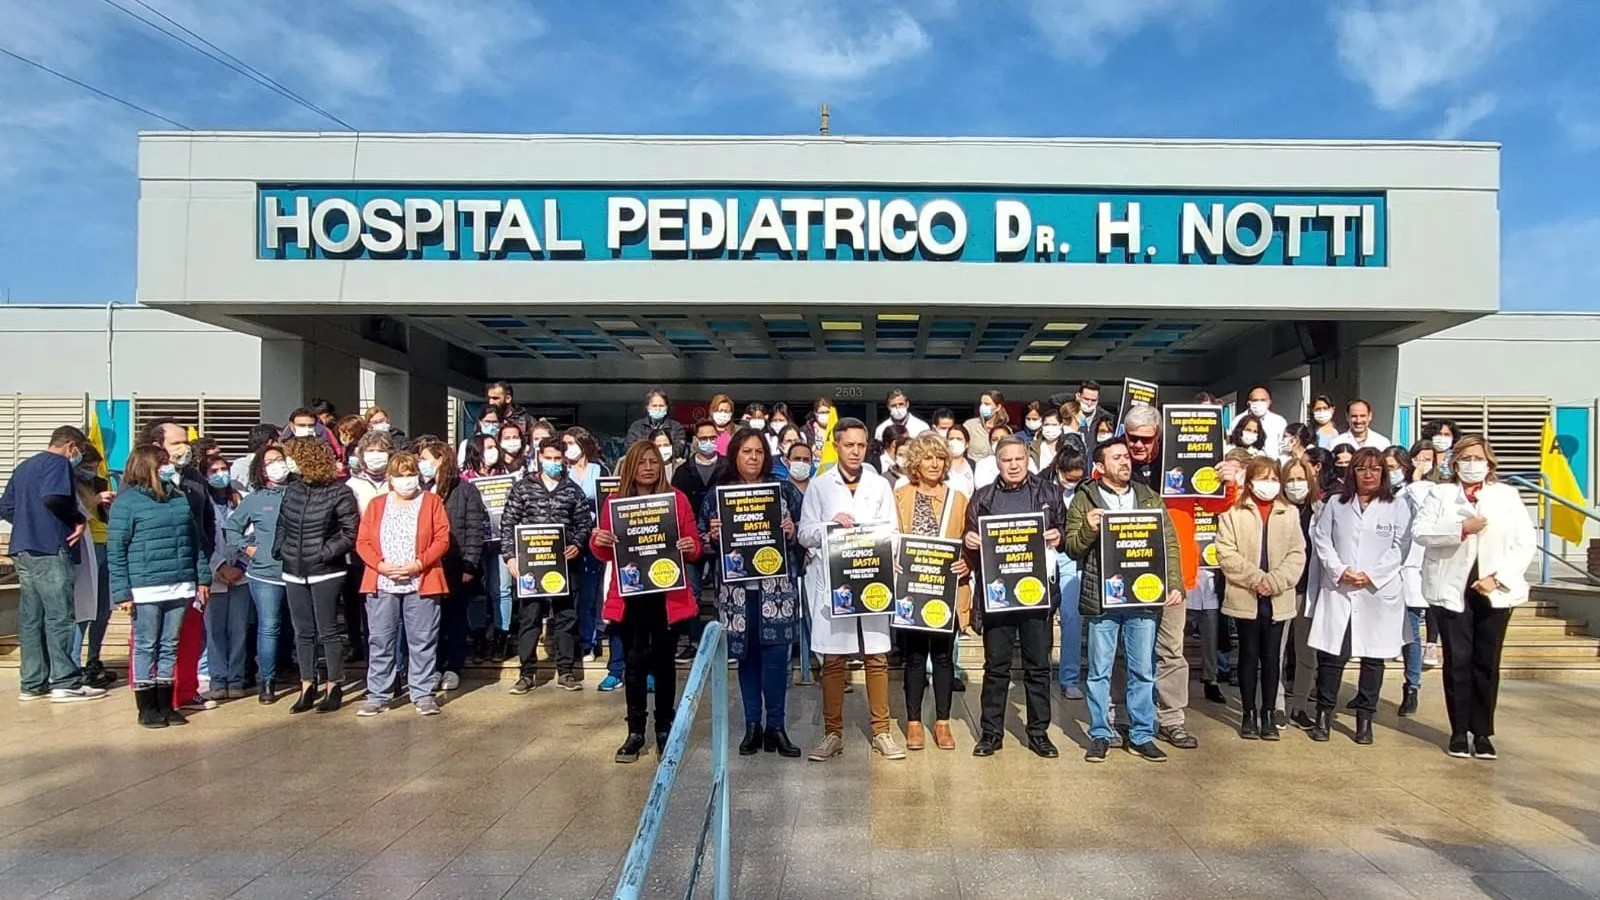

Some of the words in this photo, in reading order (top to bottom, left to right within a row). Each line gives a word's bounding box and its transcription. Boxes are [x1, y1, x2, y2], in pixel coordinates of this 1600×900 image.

[266, 196, 582, 253] HOSPITAL
[608, 197, 967, 254] PEDIATRICO
[1183, 202, 1375, 257] NOTTI
[1177, 434, 1208, 442] DECIMOS
[734, 513, 764, 523] DECIMOS
[627, 525, 659, 536] DECIMOS
[744, 520, 770, 531] BASTA!
[638, 533, 666, 544] BASTA!
[995, 544, 1027, 553] DECIMOS
[1116, 540, 1147, 548] DECIMOS
[842, 549, 874, 558] DECIMOS
[1006, 552, 1033, 562] BASTA!
[1126, 548, 1153, 558] BASTA!
[853, 557, 880, 567] BASTA!
[910, 564, 941, 574] DECIMOS
[919, 574, 945, 584] BASTA!
